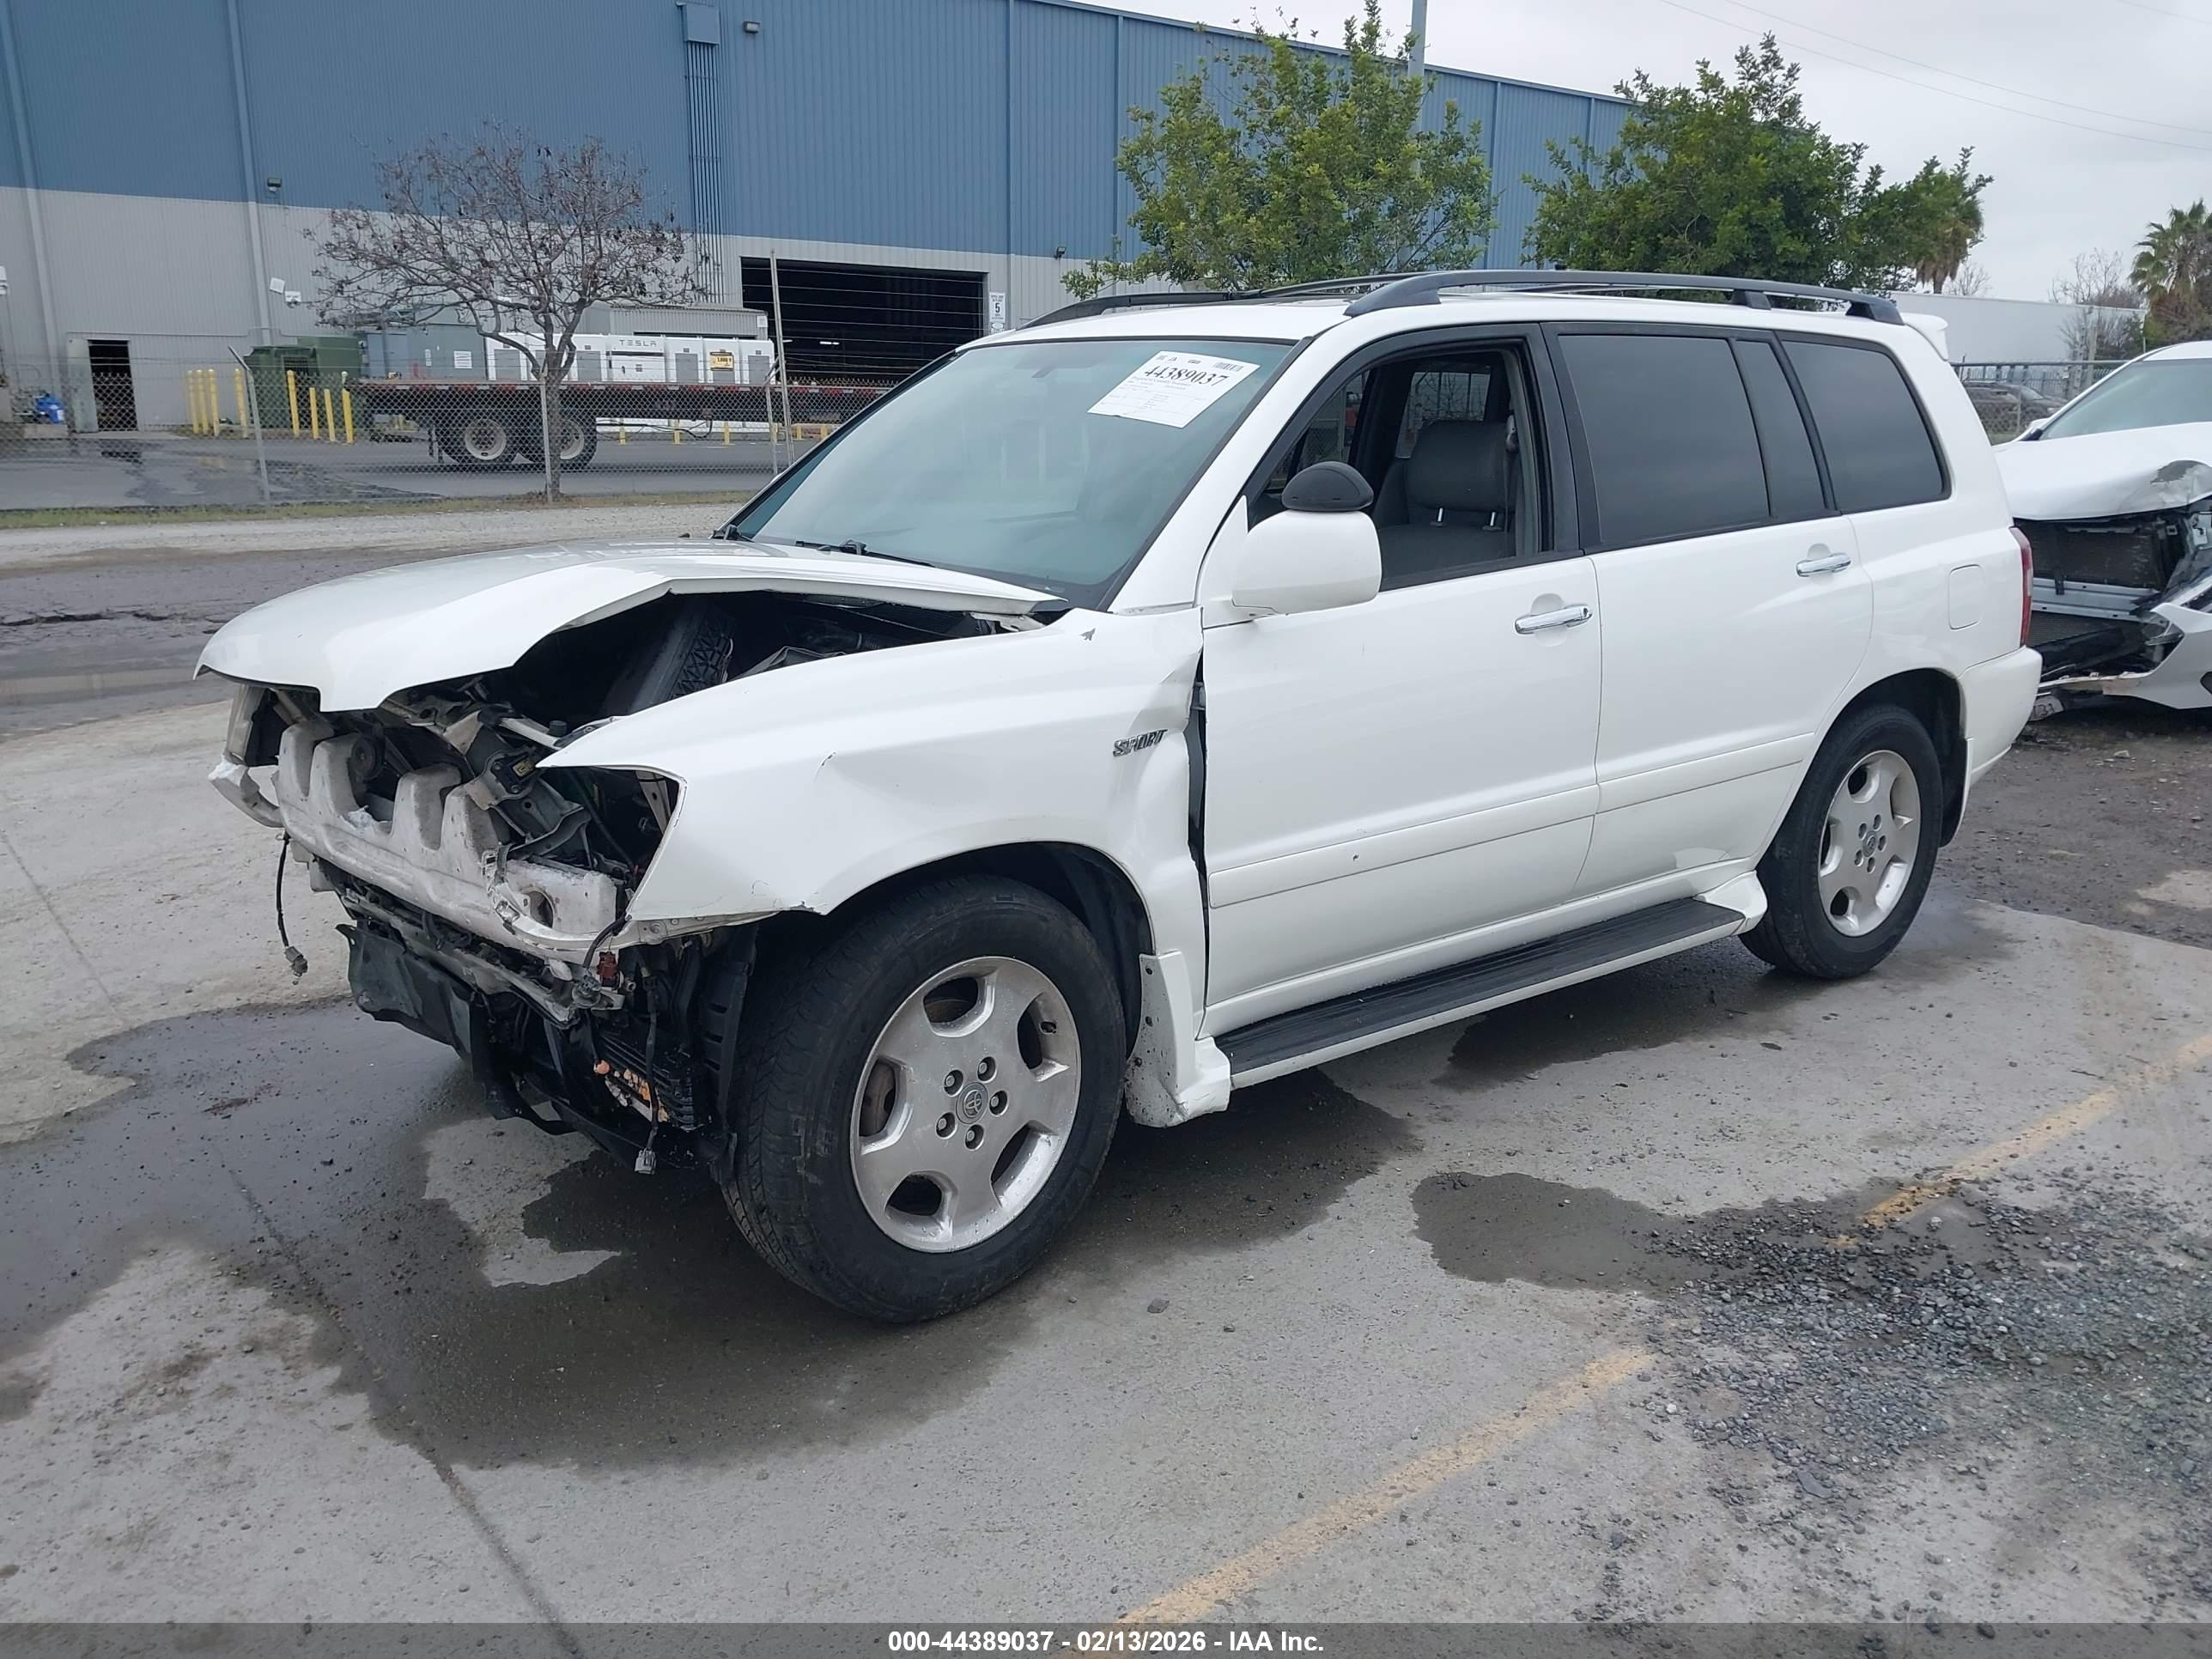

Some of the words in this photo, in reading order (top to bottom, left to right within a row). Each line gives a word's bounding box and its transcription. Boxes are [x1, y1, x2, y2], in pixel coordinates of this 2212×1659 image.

[994, 302, 1000, 313] 5
[1145, 365, 1230, 386] 44389037
[1113, 729, 1168, 757] SPORT
